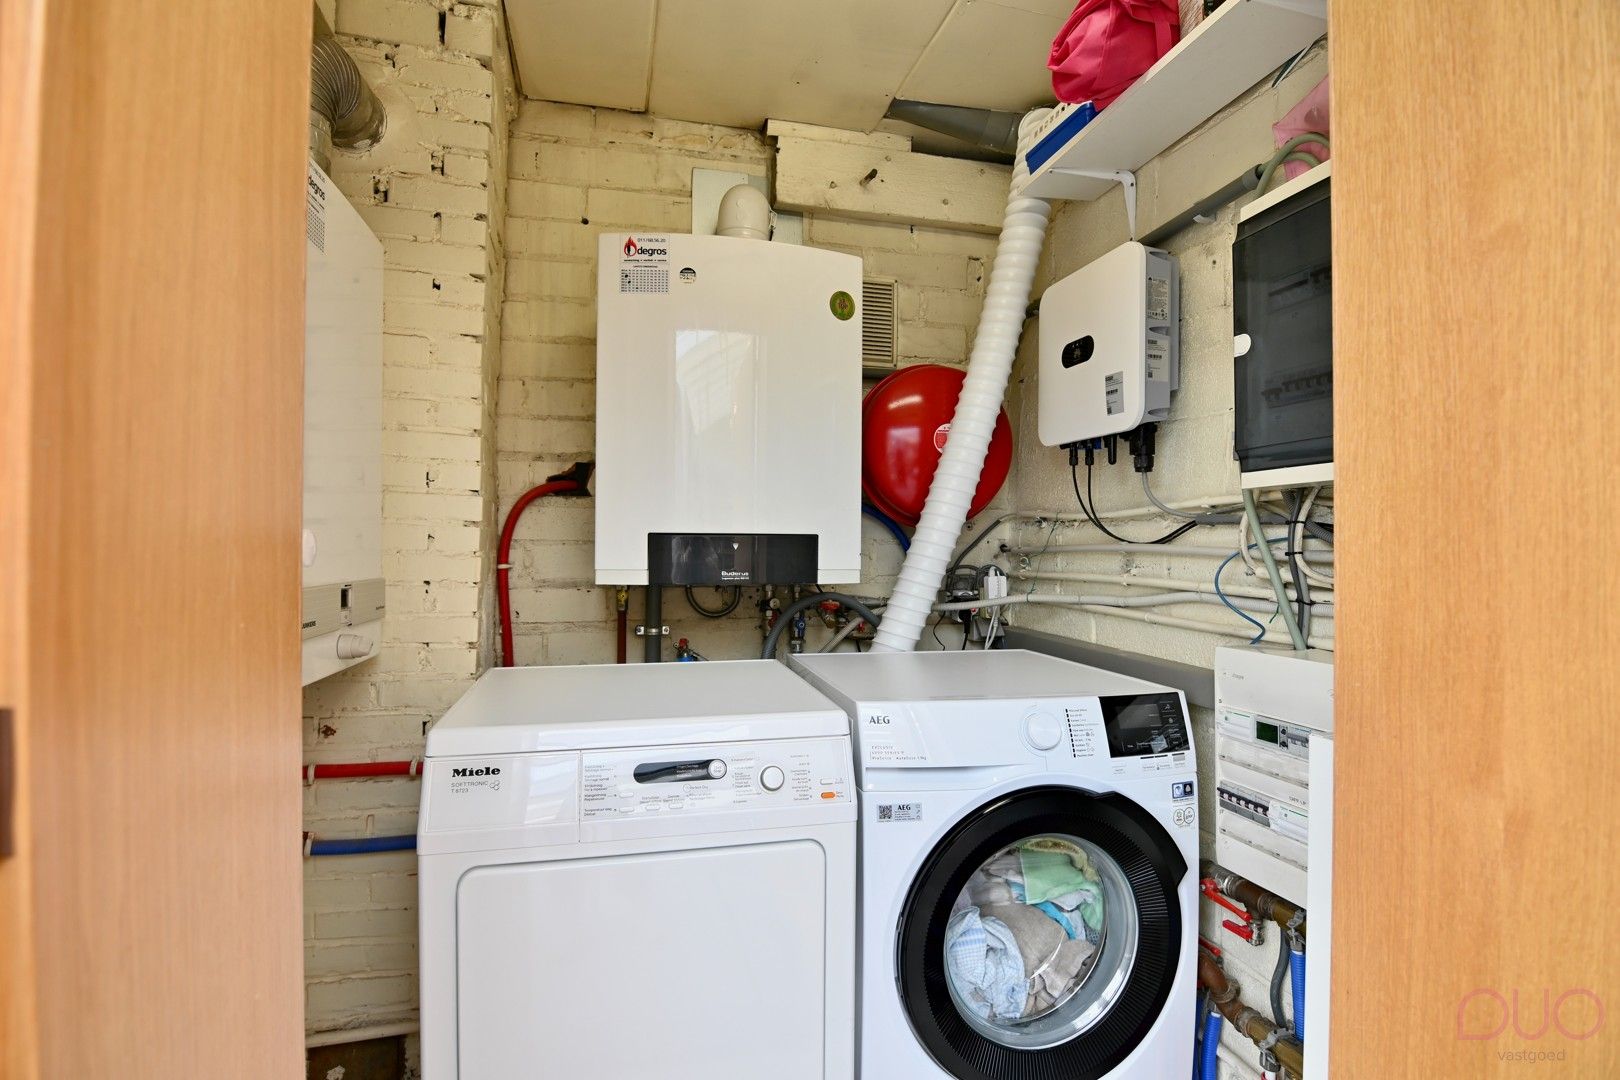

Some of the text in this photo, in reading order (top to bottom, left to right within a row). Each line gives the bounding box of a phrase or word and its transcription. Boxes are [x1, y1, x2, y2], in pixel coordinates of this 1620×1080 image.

[637, 247, 667, 256] degros
[869, 715, 890, 725] AEG
[452, 766, 501, 778] Miele
[451, 780, 488, 788] SOFTTRONIC
